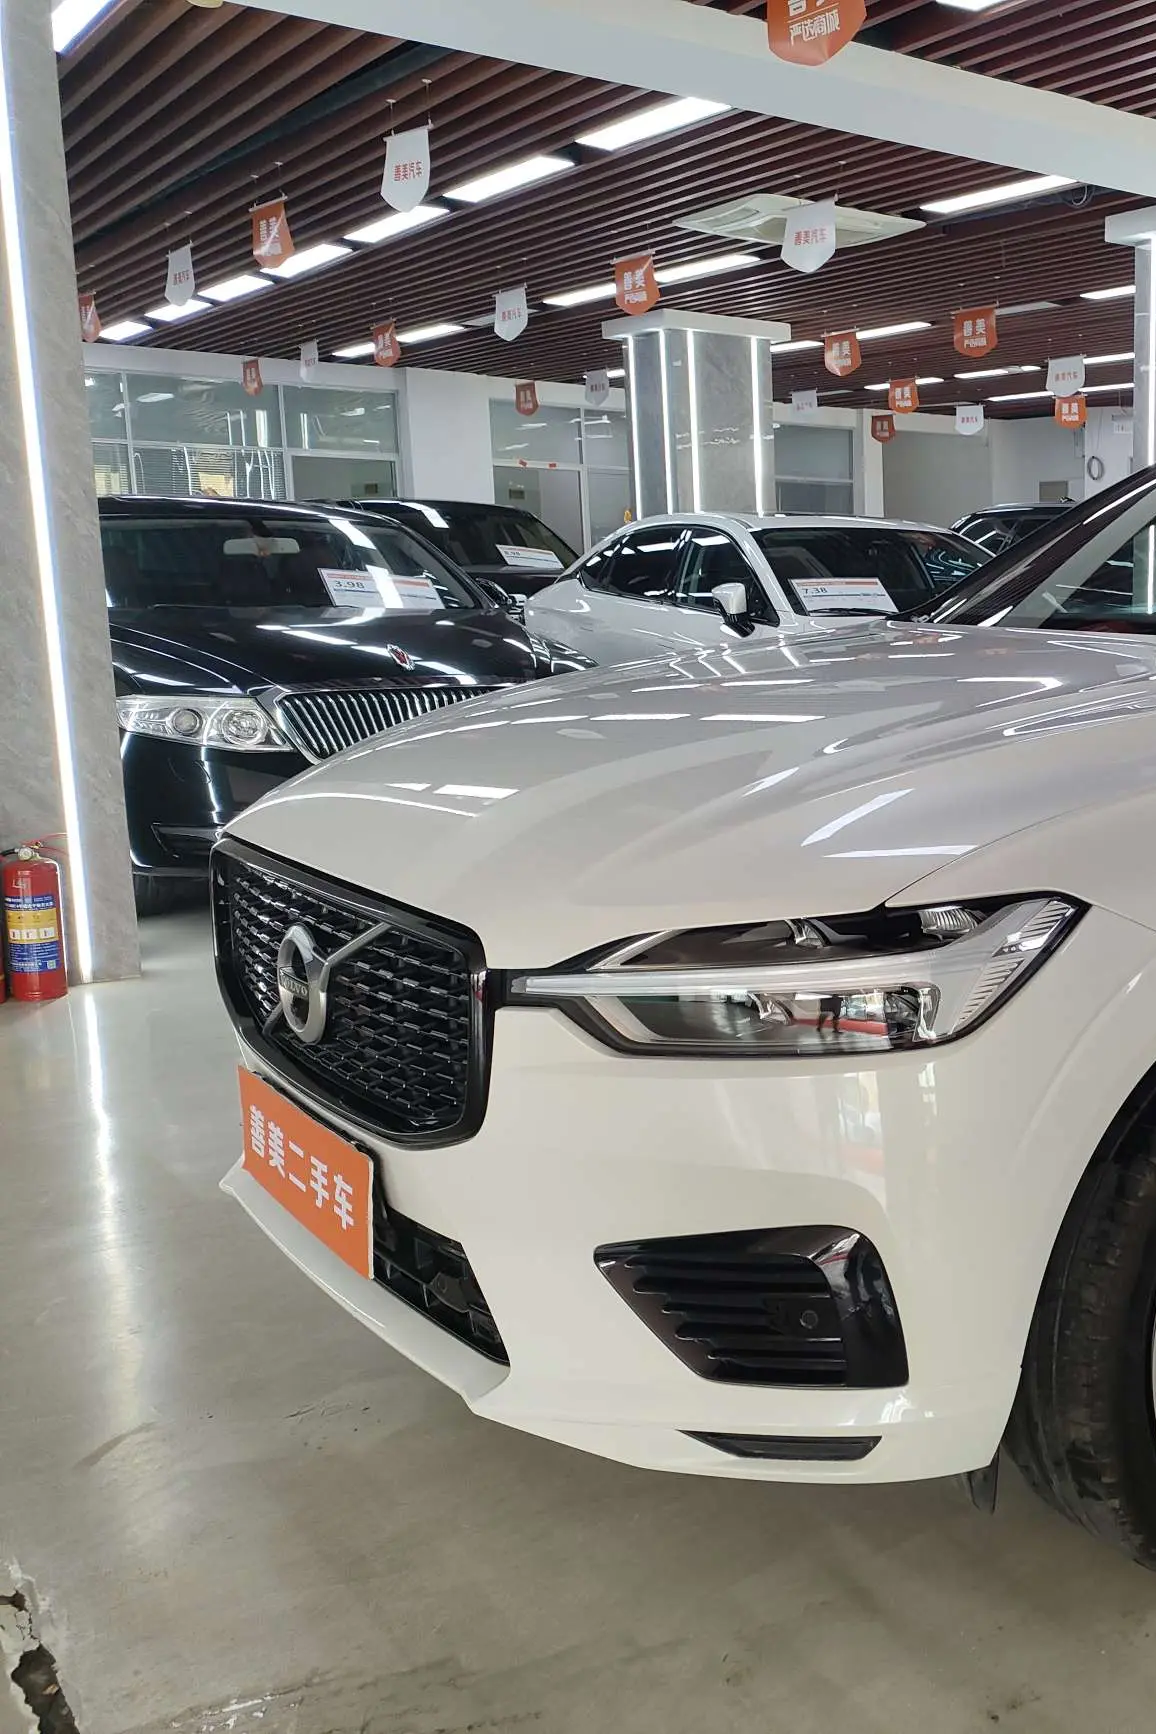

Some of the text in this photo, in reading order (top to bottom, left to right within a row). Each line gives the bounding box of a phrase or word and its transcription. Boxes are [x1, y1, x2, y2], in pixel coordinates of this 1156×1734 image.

[335, 580, 365, 589] 3.98
[248, 1104, 355, 1231] 善美二手车
